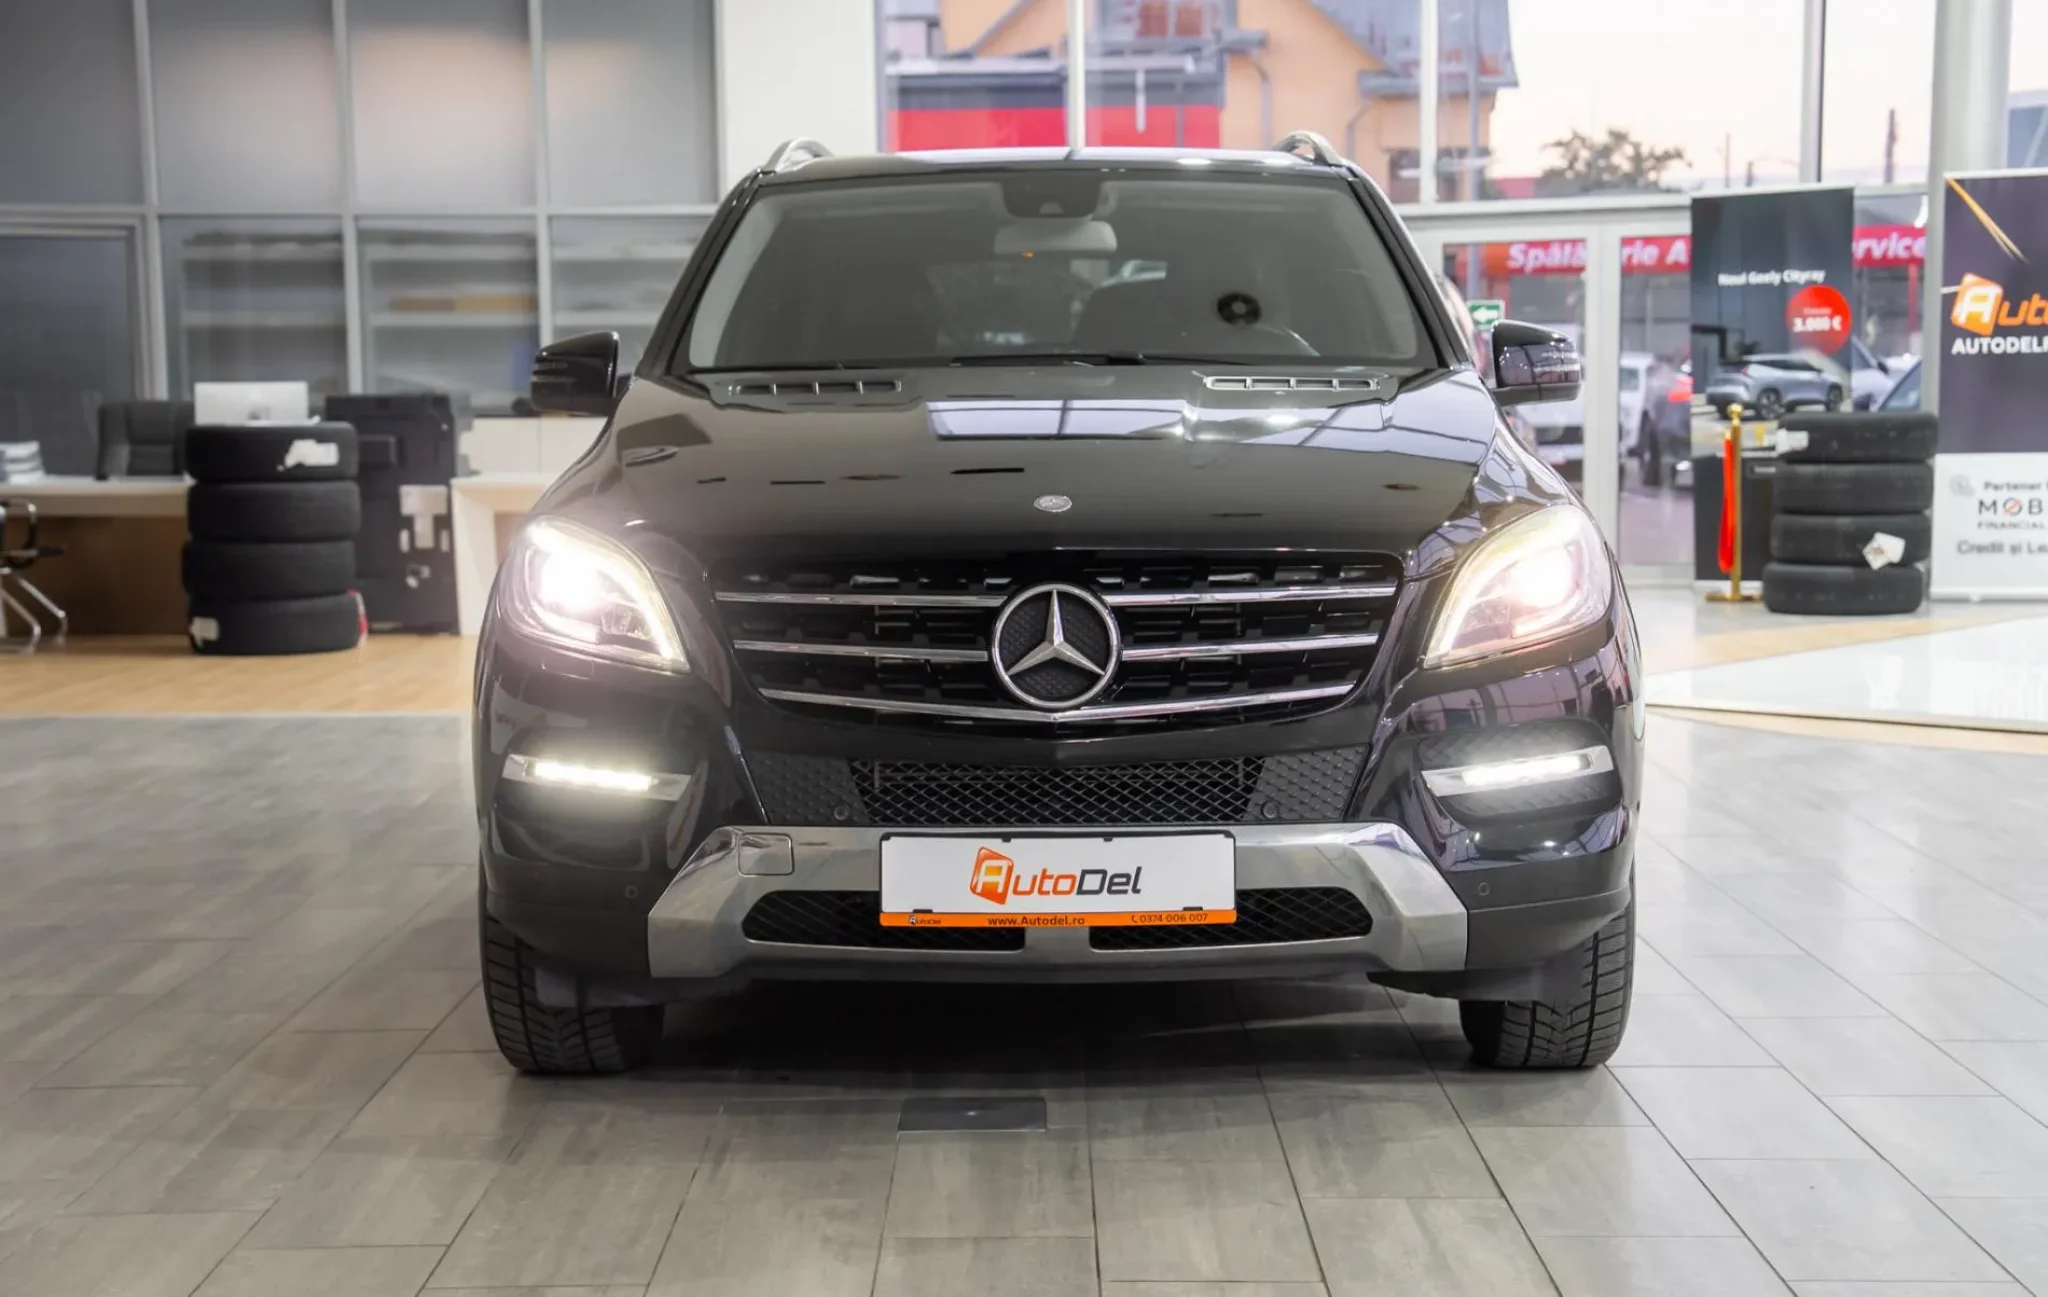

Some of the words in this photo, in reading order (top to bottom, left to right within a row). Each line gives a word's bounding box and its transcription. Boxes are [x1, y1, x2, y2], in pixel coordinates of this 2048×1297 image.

[1953, 277, 2048, 331] Aut
[1957, 539, 2004, 555] Credit
[971, 851, 1142, 901] AutoDel
[987, 915, 1085, 926] www.Autodel.ro
[1139, 914, 1163, 924] 0374
[1166, 913, 1187, 923] 006
[1188, 912, 1208, 922] 007
